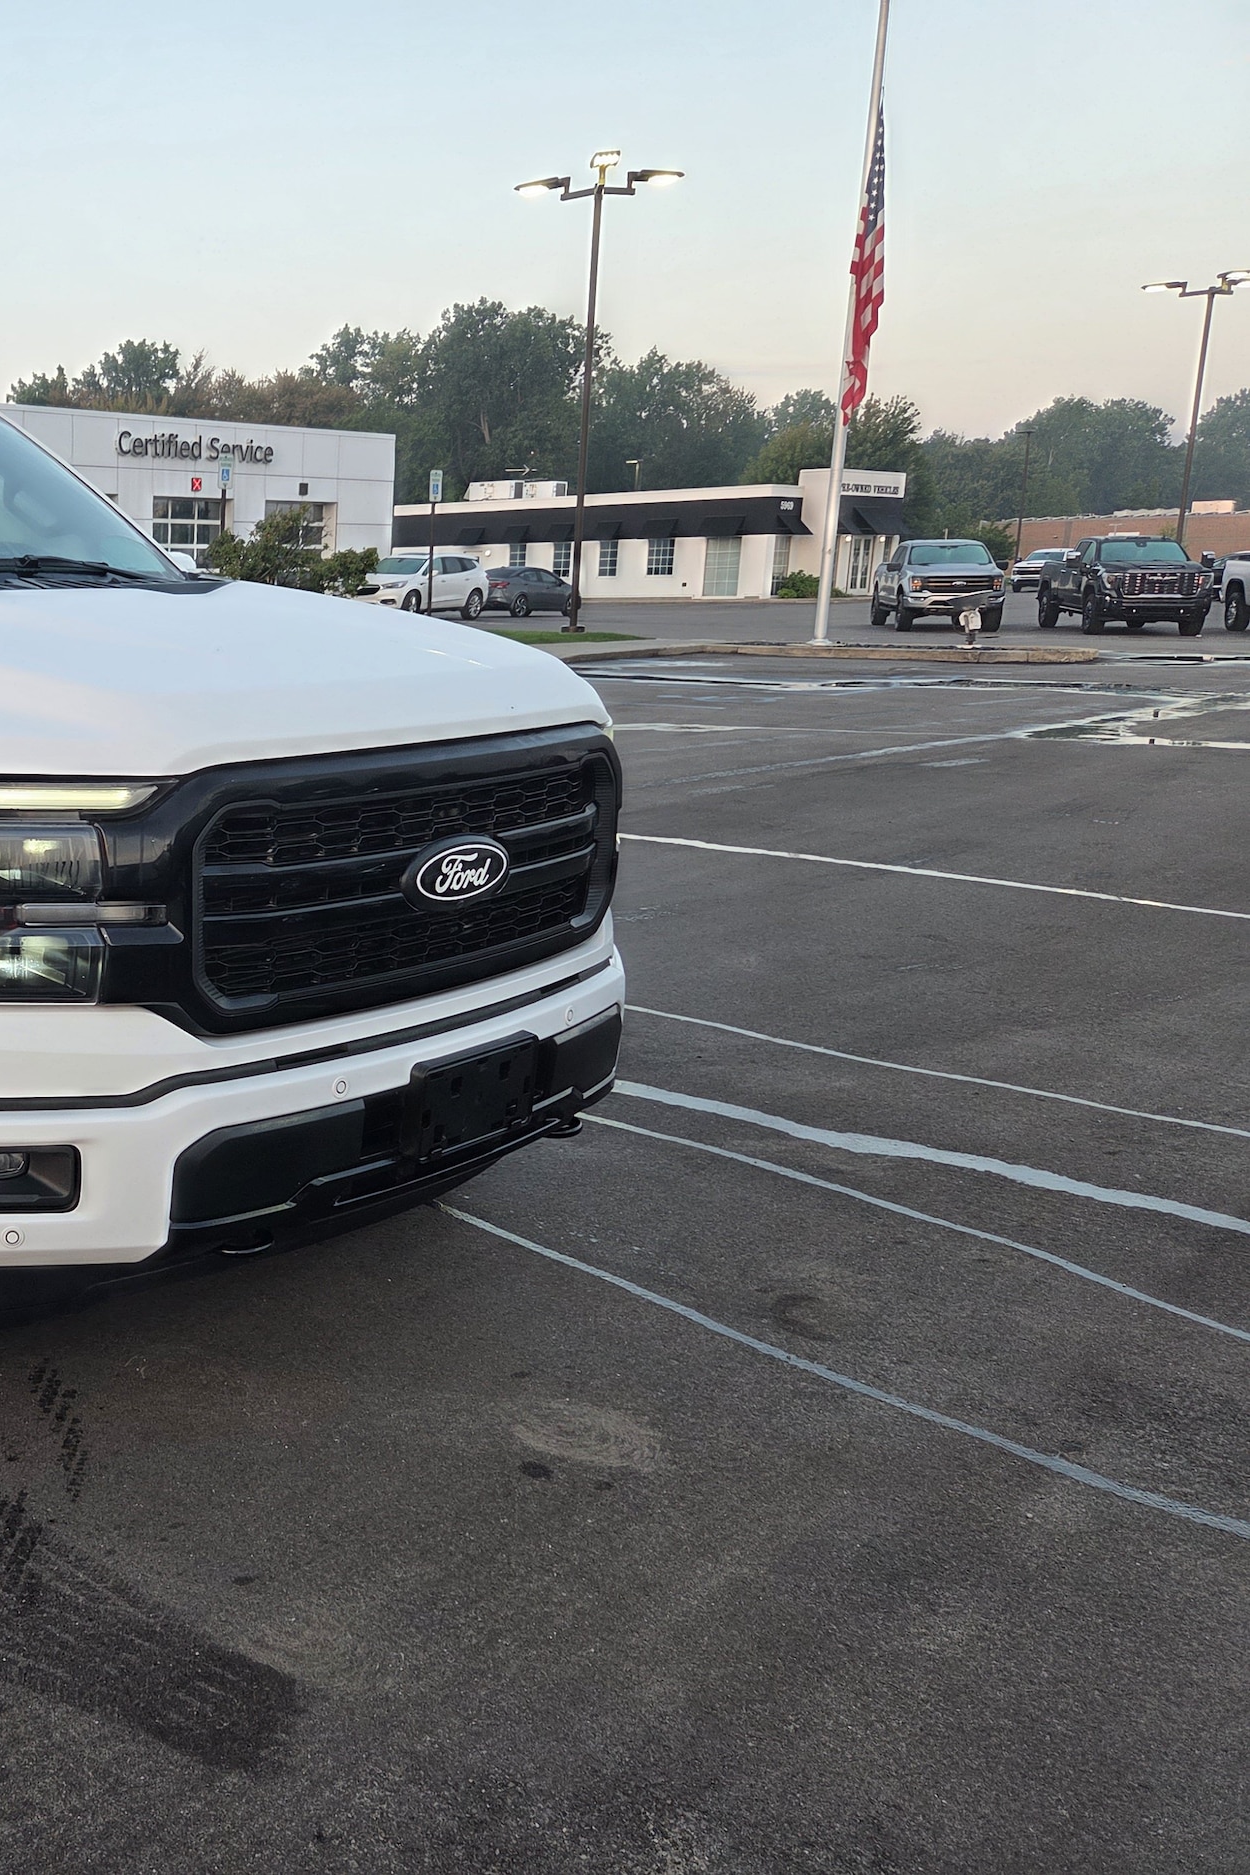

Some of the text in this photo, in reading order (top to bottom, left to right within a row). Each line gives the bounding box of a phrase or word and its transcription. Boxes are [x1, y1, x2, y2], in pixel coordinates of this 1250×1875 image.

[118, 430, 274, 464] Certified Service
[841, 483, 871, 493] RE-OWNED
[435, 853, 491, 893] Ford
